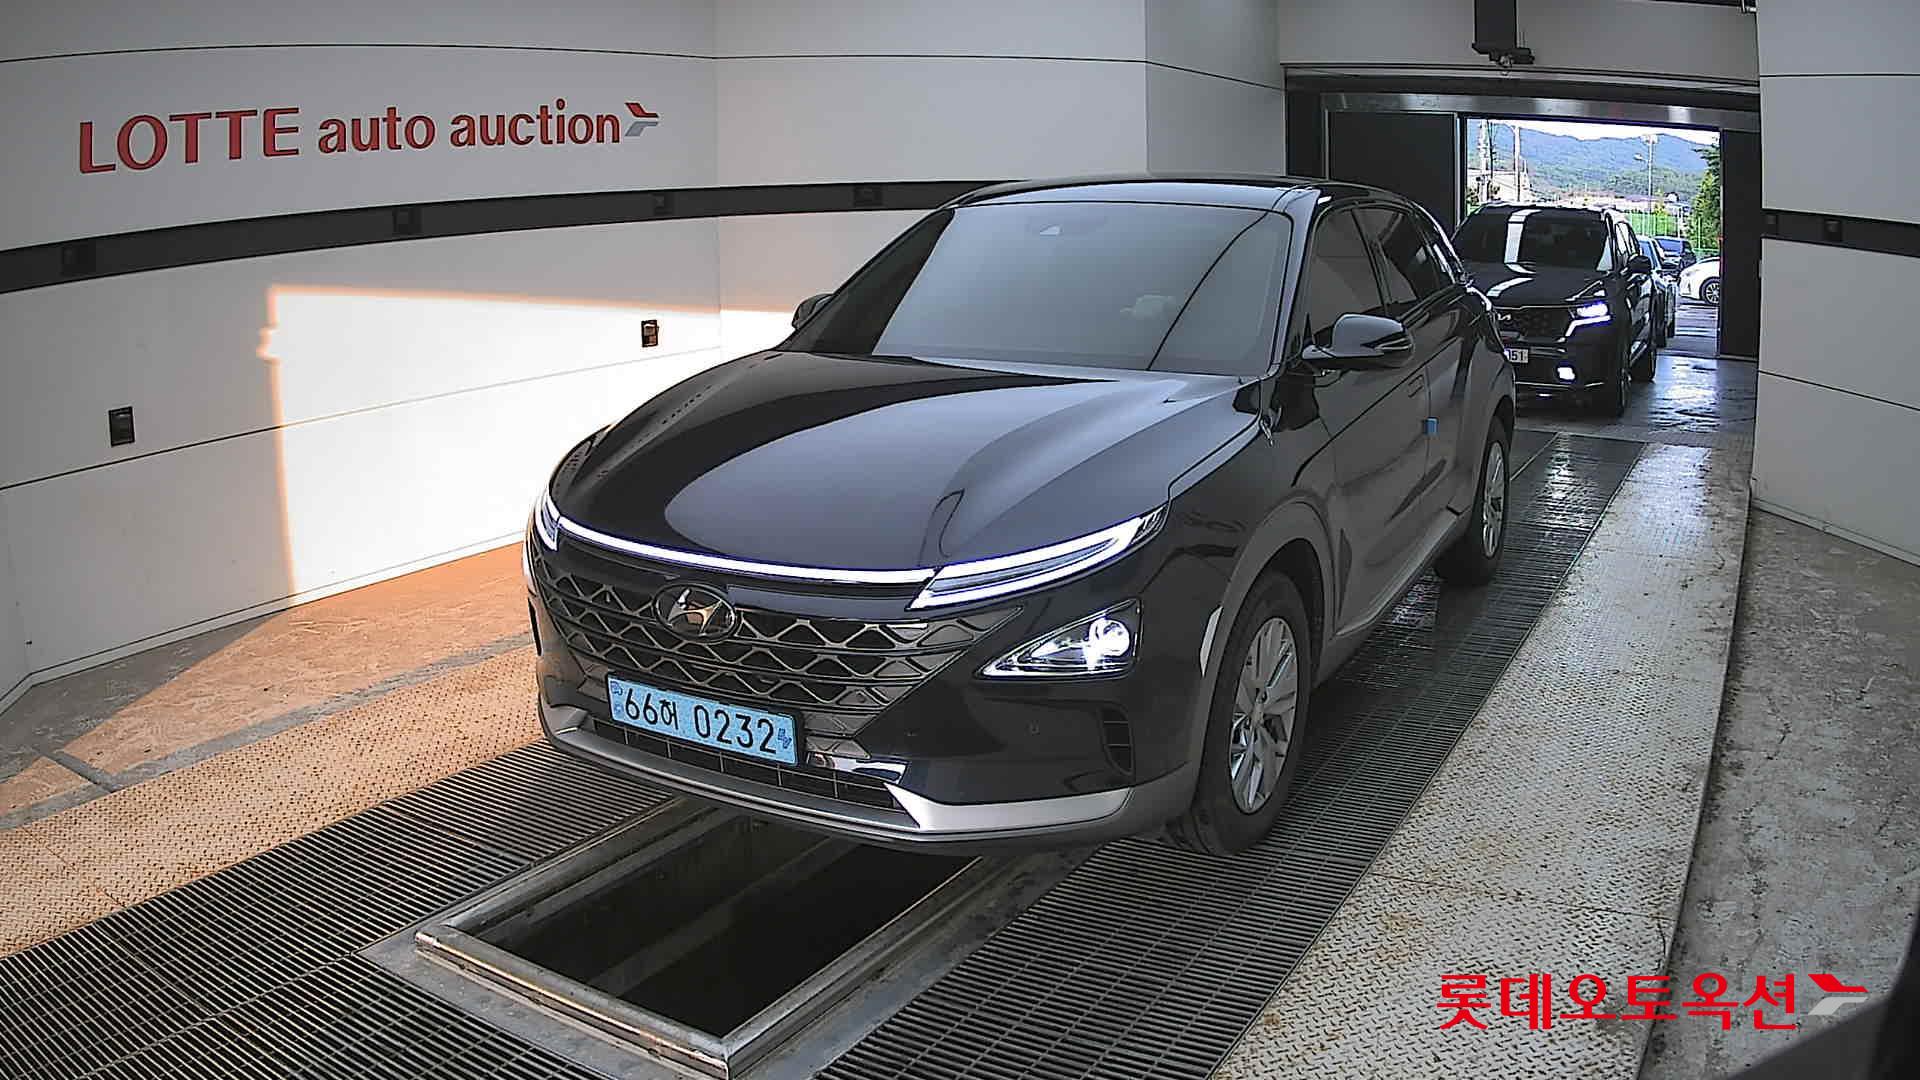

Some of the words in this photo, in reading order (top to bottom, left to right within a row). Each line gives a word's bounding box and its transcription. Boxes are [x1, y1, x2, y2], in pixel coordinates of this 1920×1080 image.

[79, 107, 298, 174] LOTTE
[318, 106, 436, 154] auto
[450, 99, 622, 148] auction
[624, 687, 680, 731] 66허
[693, 704, 777, 755] 0232
